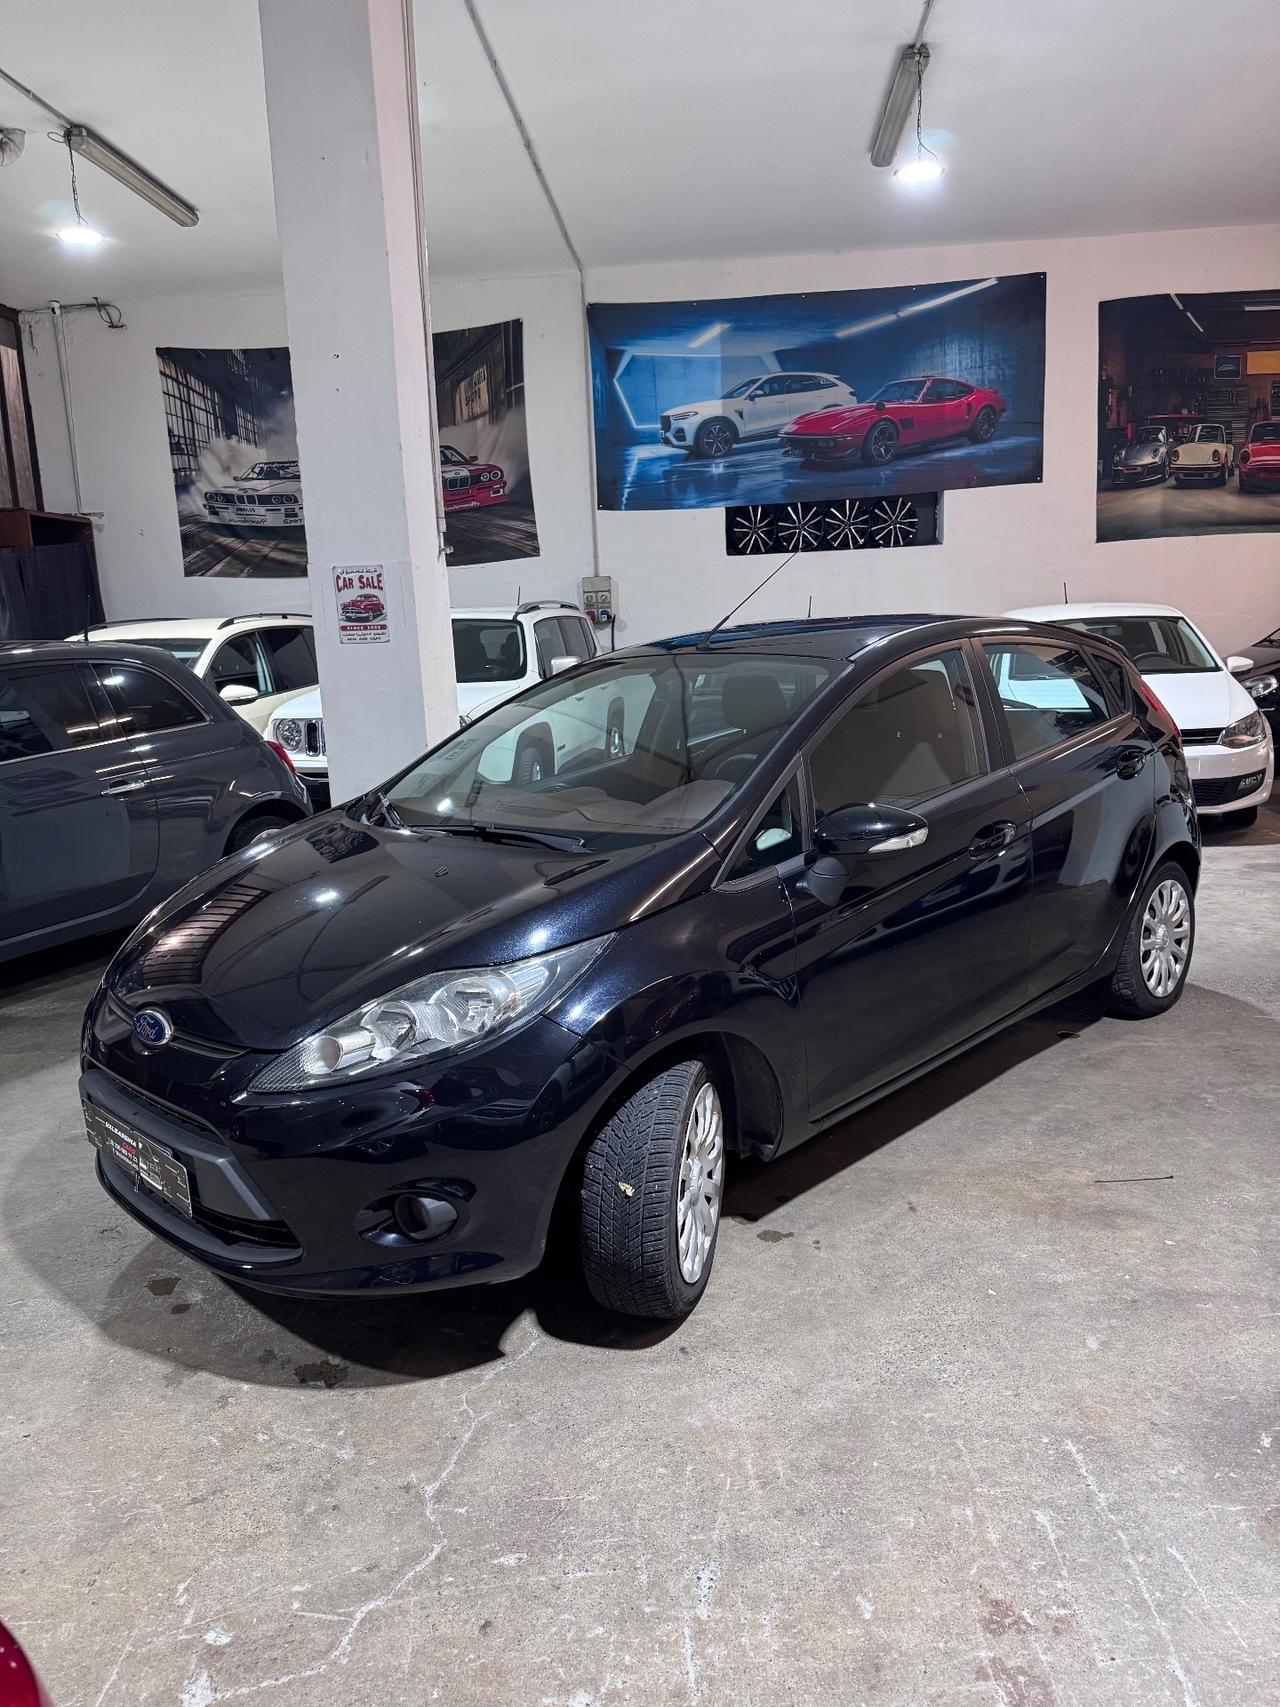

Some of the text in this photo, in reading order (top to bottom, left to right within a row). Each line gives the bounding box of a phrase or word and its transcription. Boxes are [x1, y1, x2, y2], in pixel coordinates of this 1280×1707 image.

[336, 573, 384, 593] CAR SALE
[134, 1014, 160, 1040] Ford
